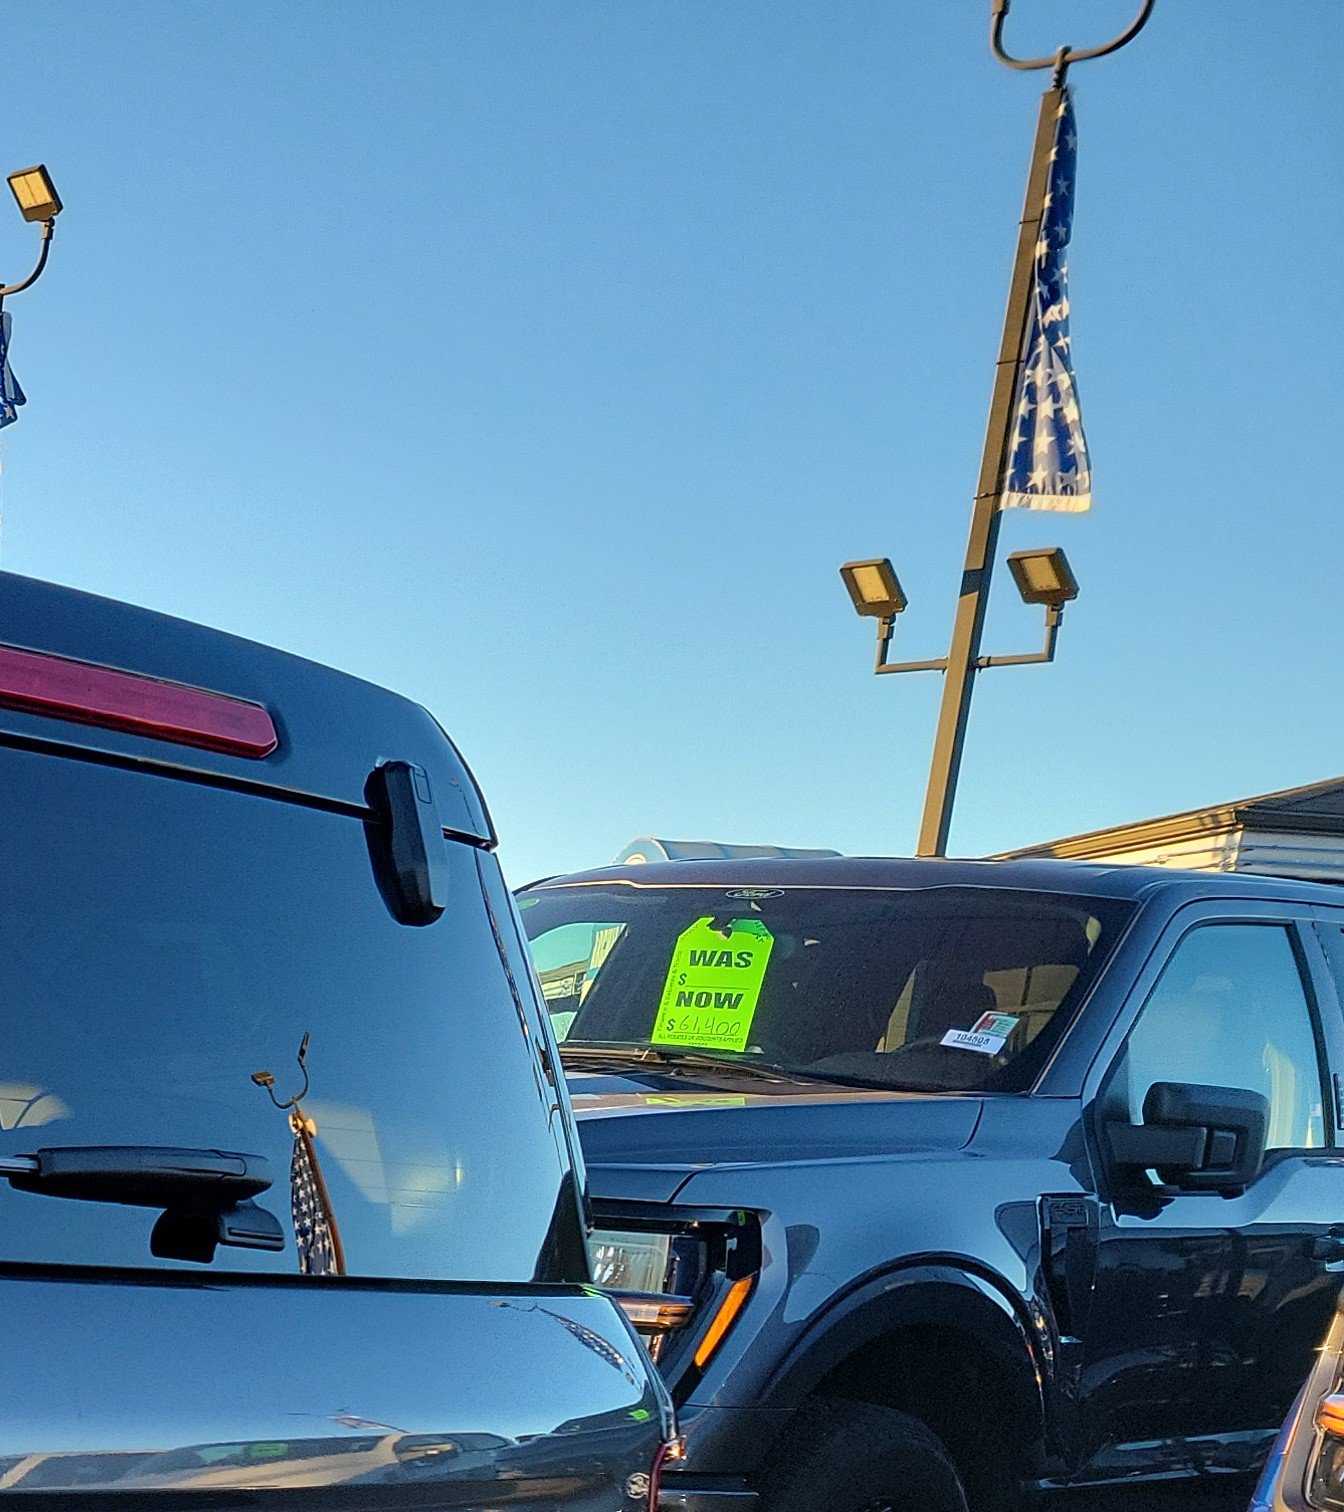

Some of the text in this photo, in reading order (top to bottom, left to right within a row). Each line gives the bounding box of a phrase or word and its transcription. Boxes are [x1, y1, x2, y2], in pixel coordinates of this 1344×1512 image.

[689, 949, 754, 968] WAS
[678, 972, 687, 987] $
[675, 990, 745, 1010] NOW
[666, 1018, 676, 1032] $
